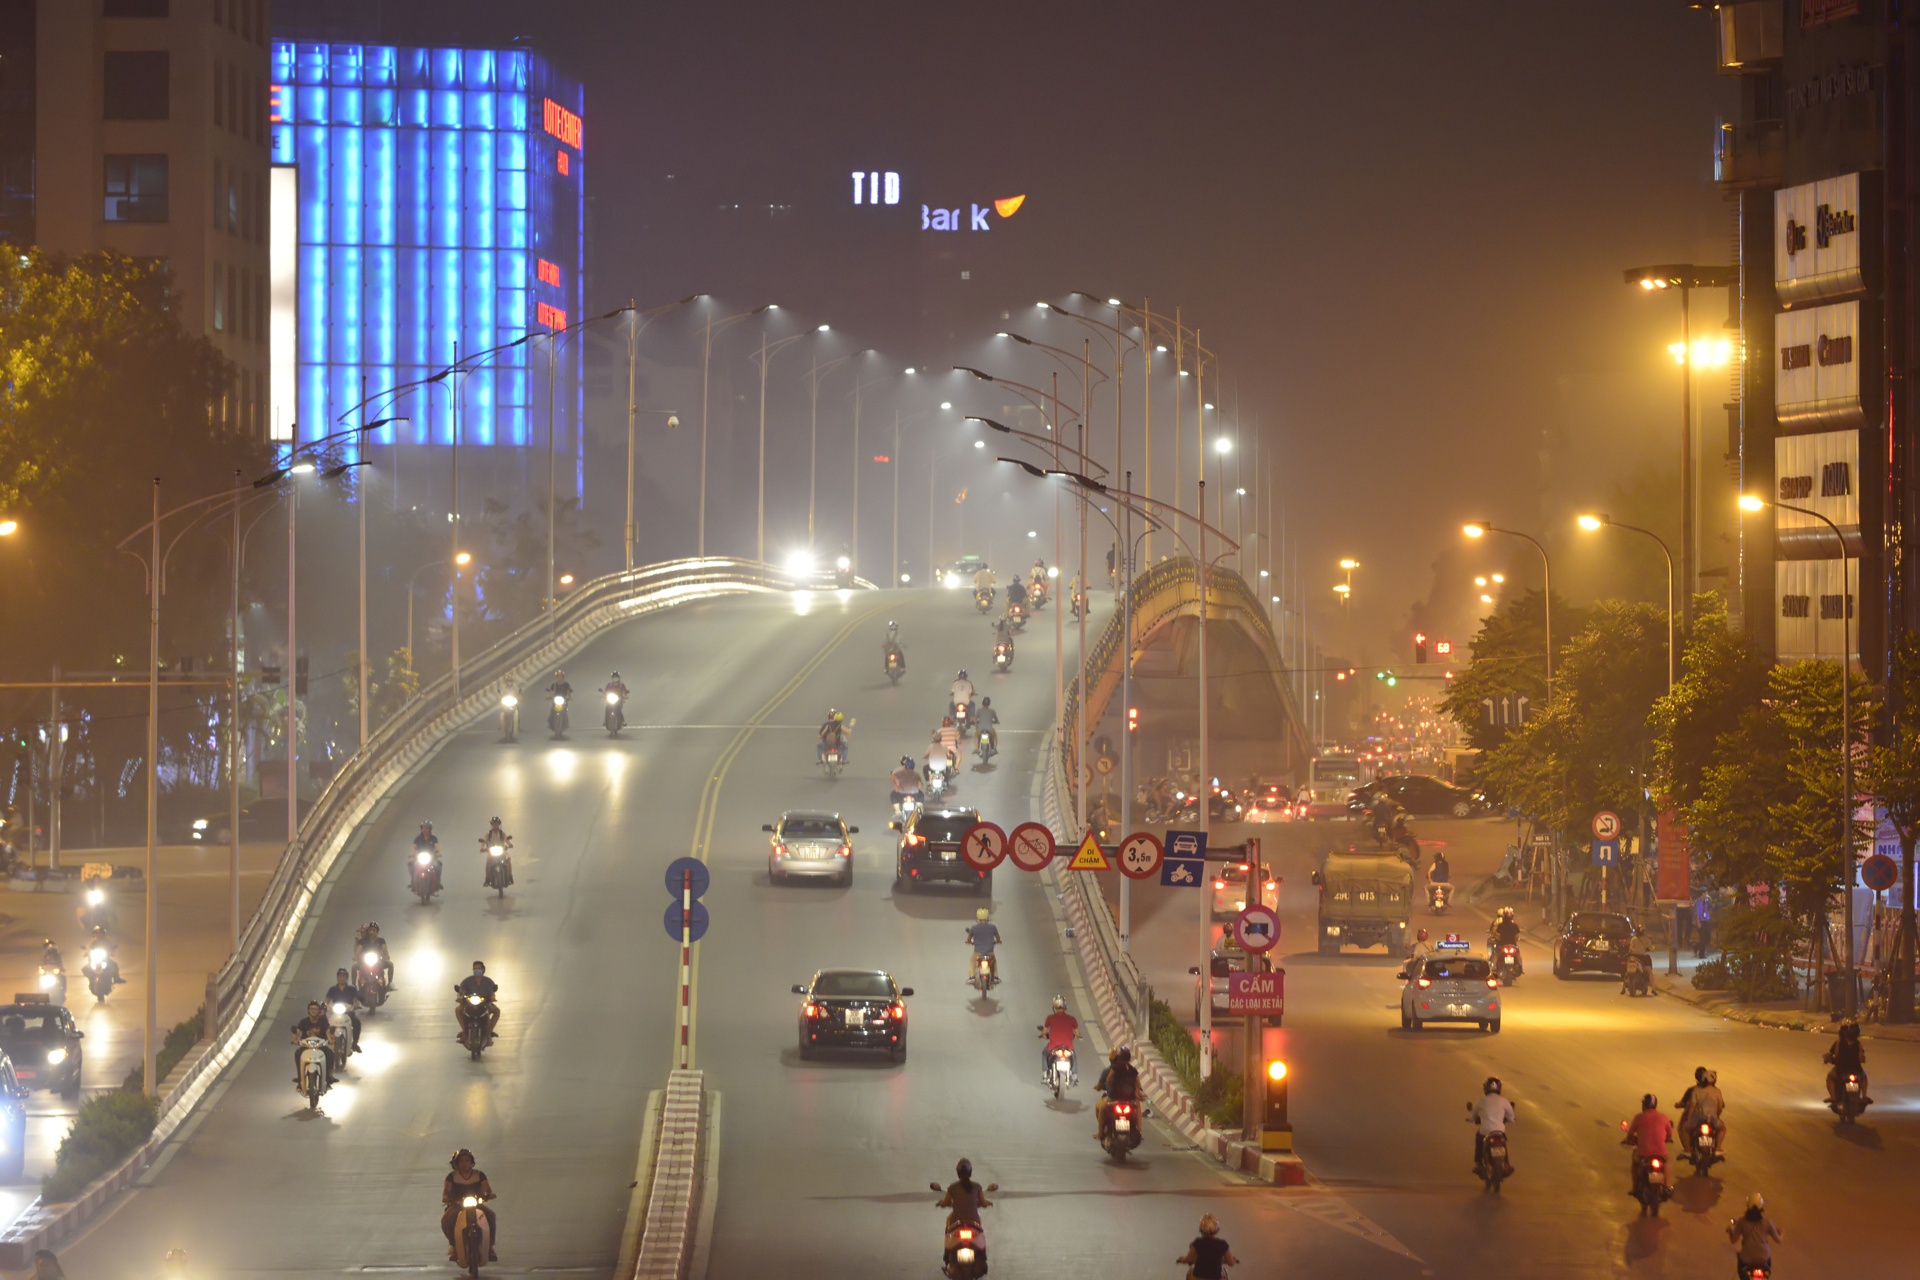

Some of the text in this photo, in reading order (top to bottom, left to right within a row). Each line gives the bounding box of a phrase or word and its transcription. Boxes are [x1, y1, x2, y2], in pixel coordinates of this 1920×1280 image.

[543, 97, 583, 150] LOTTE CENTER
[1779, 475, 1813, 500] SHARP
[1821, 461, 1851, 497] AQUA
[1782, 594, 1810, 618] SONY
[1437, 642, 1450, 654] 68
[1239, 974, 1275, 994] CẤM
[1230, 995, 1283, 1010] CÁC LOẠI XE TẢI
